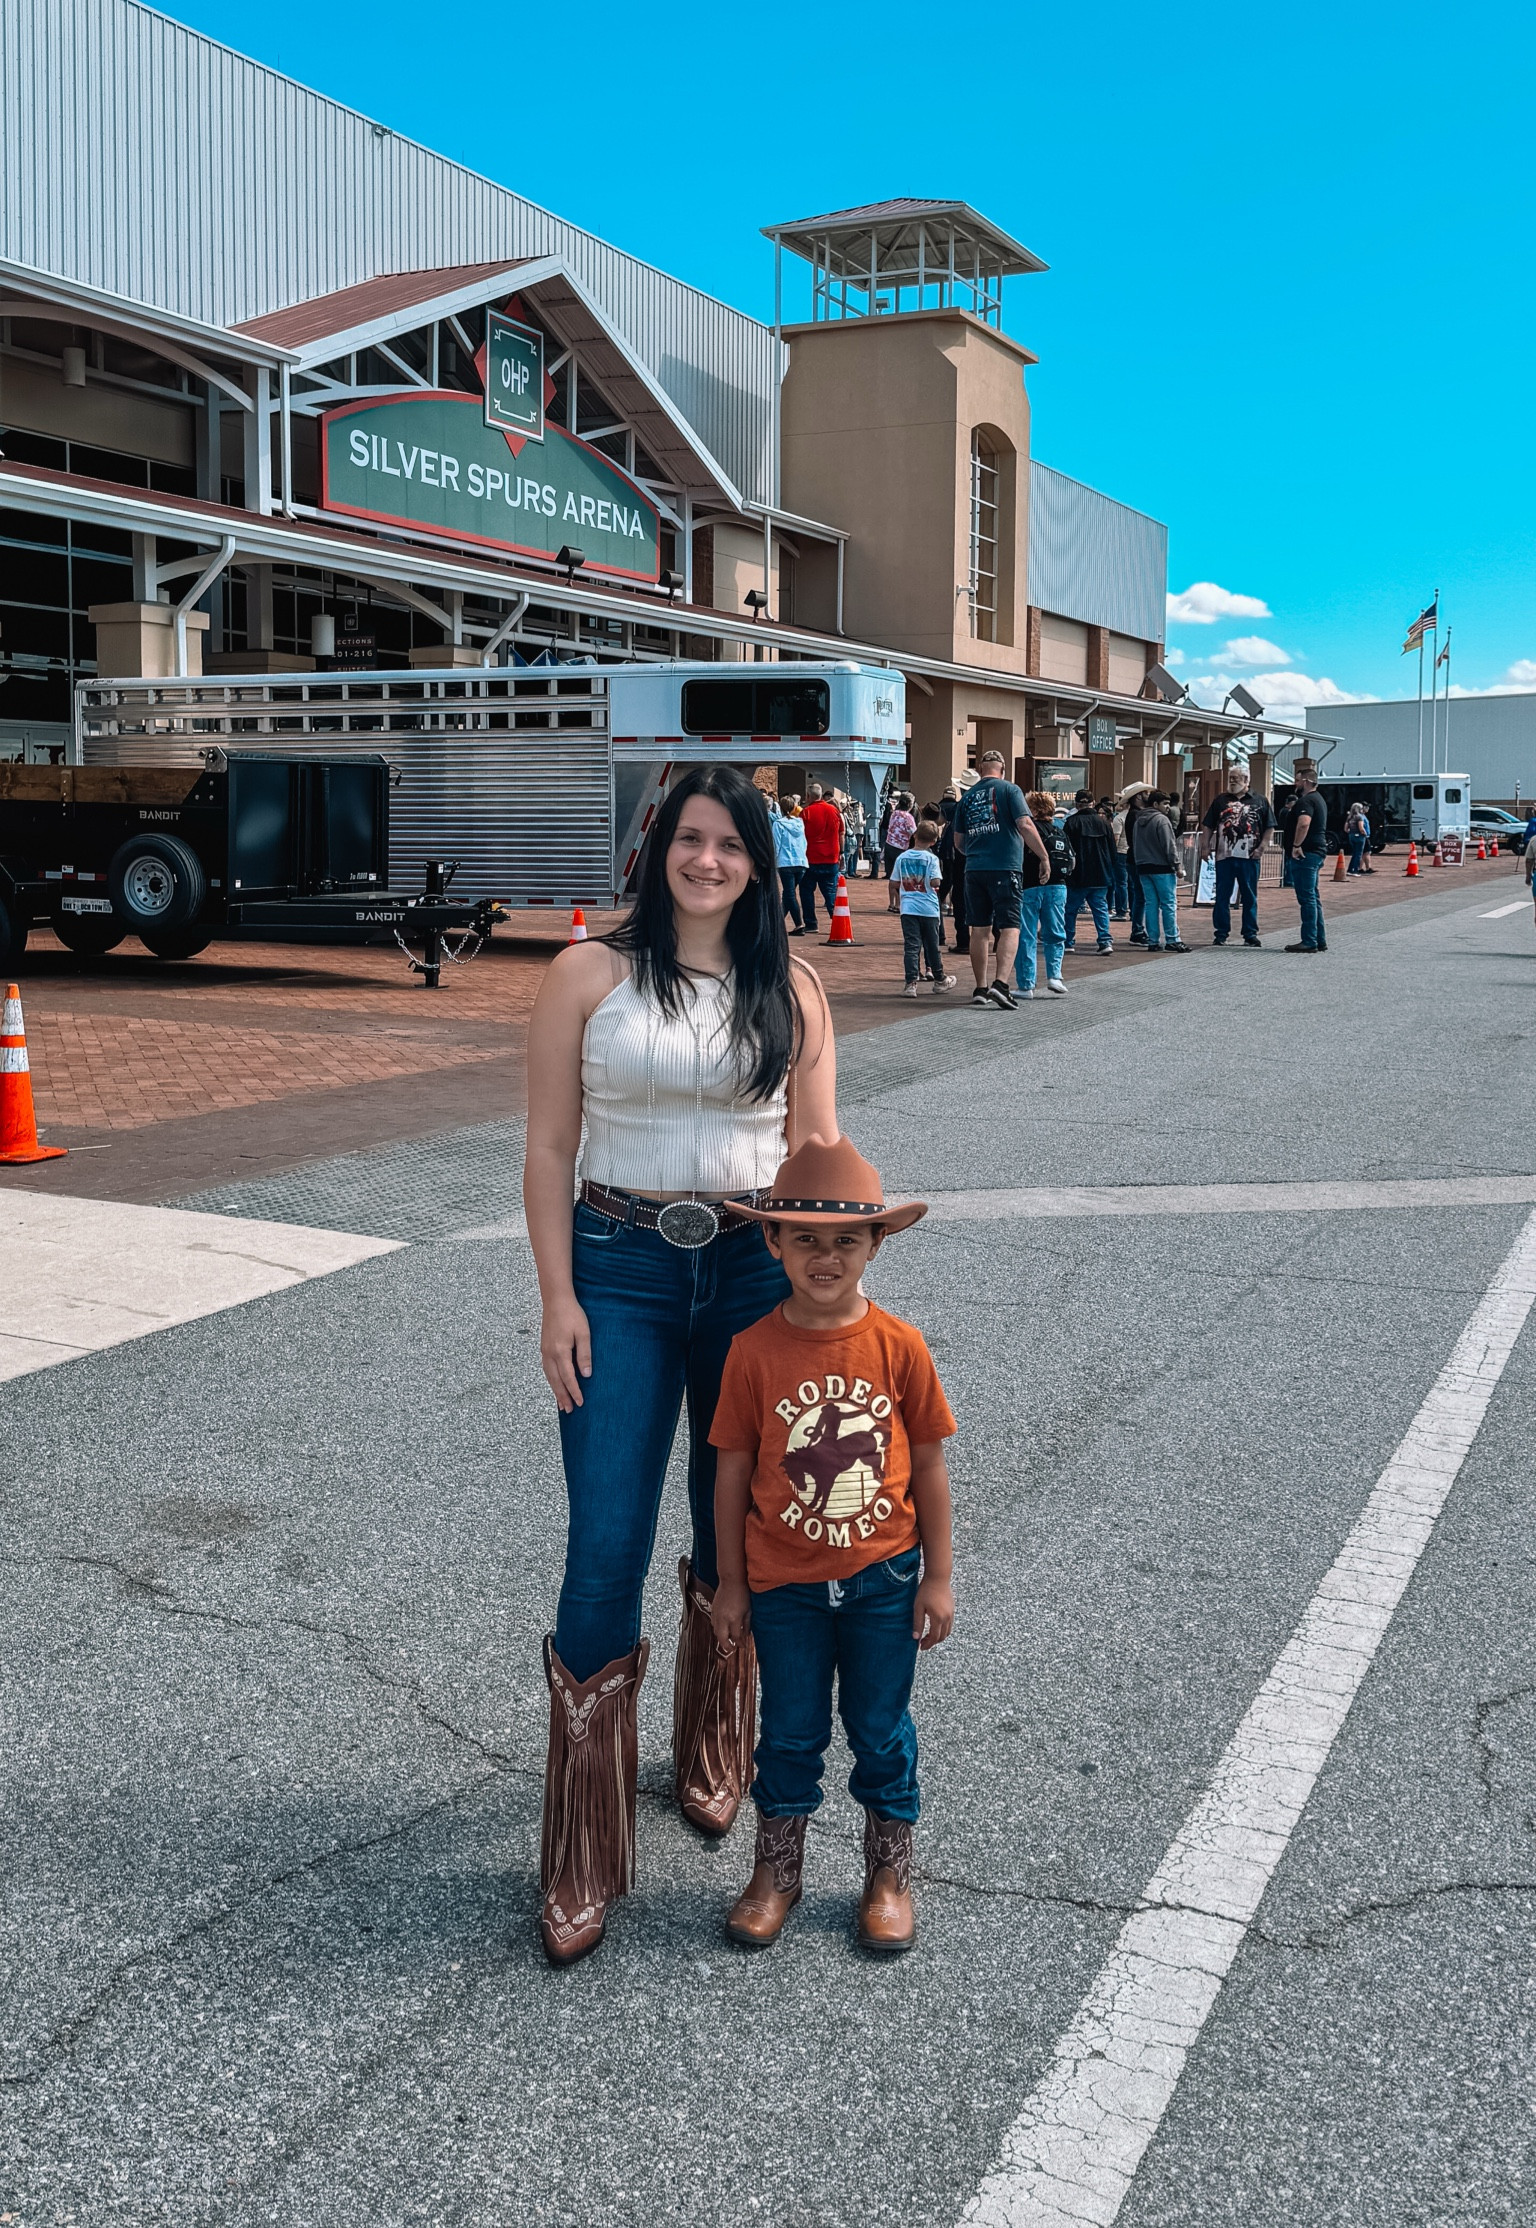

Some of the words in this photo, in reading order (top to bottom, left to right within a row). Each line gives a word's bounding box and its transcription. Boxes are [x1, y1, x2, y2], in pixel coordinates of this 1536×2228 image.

[501, 358, 529, 396] OHP
[349, 429, 461, 493] SILVER
[466, 463, 557, 517] SPURS
[562, 491, 645, 541] ARENA
[336, 638, 373, 646] ECTIONS
[332, 650, 373, 658] 01-216
[1096, 718, 1108, 733] BOX
[1091, 735, 1113, 750] OFFICE
[1062, 791, 1077, 801] WIF
[139, 810, 181, 821] BANDIT
[355, 911, 406, 922] BANDIT
[774, 1374, 893, 1427] RODEO
[779, 1497, 893, 1549] ROMEO
